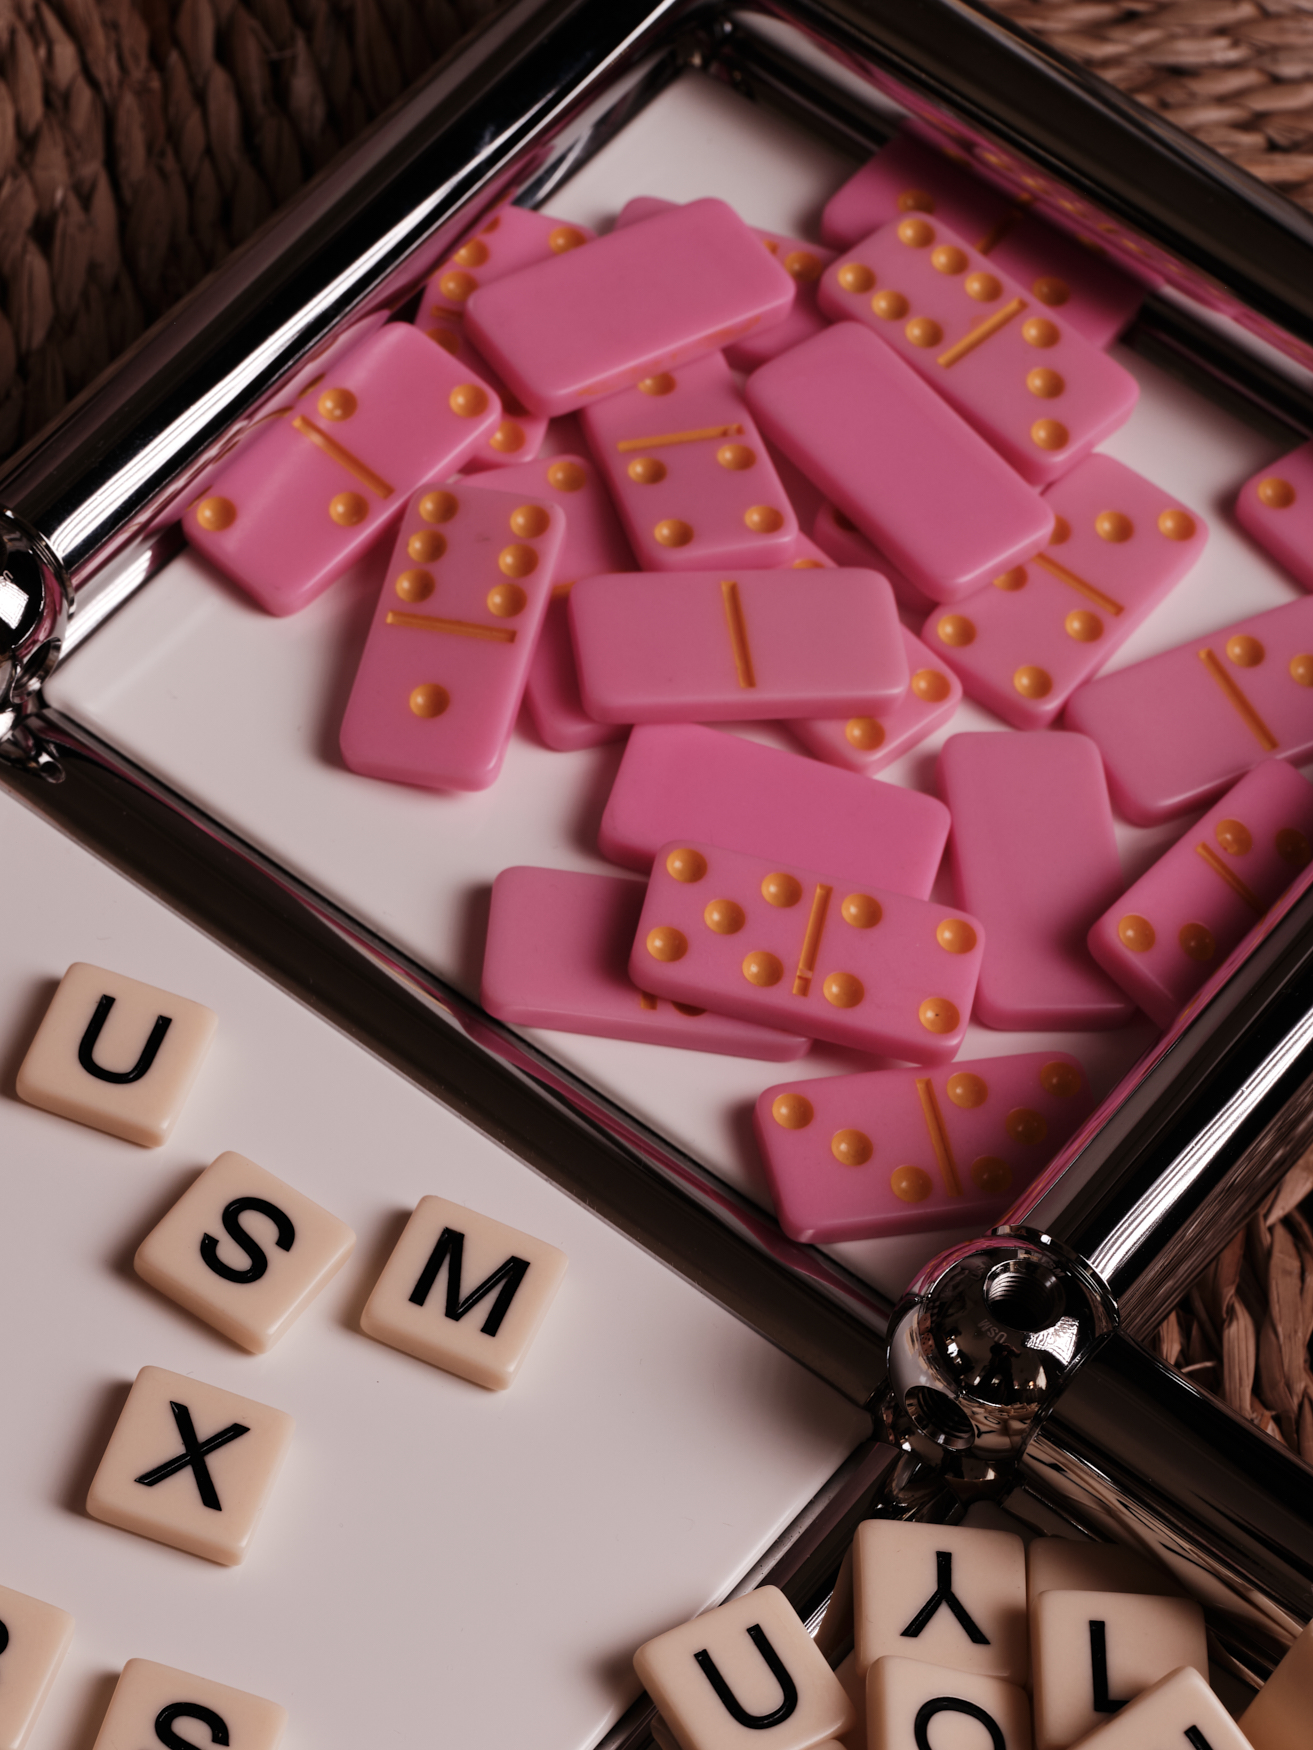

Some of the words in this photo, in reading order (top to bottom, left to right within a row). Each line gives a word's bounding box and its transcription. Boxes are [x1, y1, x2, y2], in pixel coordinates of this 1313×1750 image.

[976, 1318, 1007, 1343] USM
[134, 1400, 251, 1512] X
[900, 1550, 991, 1645] Y
[693, 1623, 797, 1730] U
